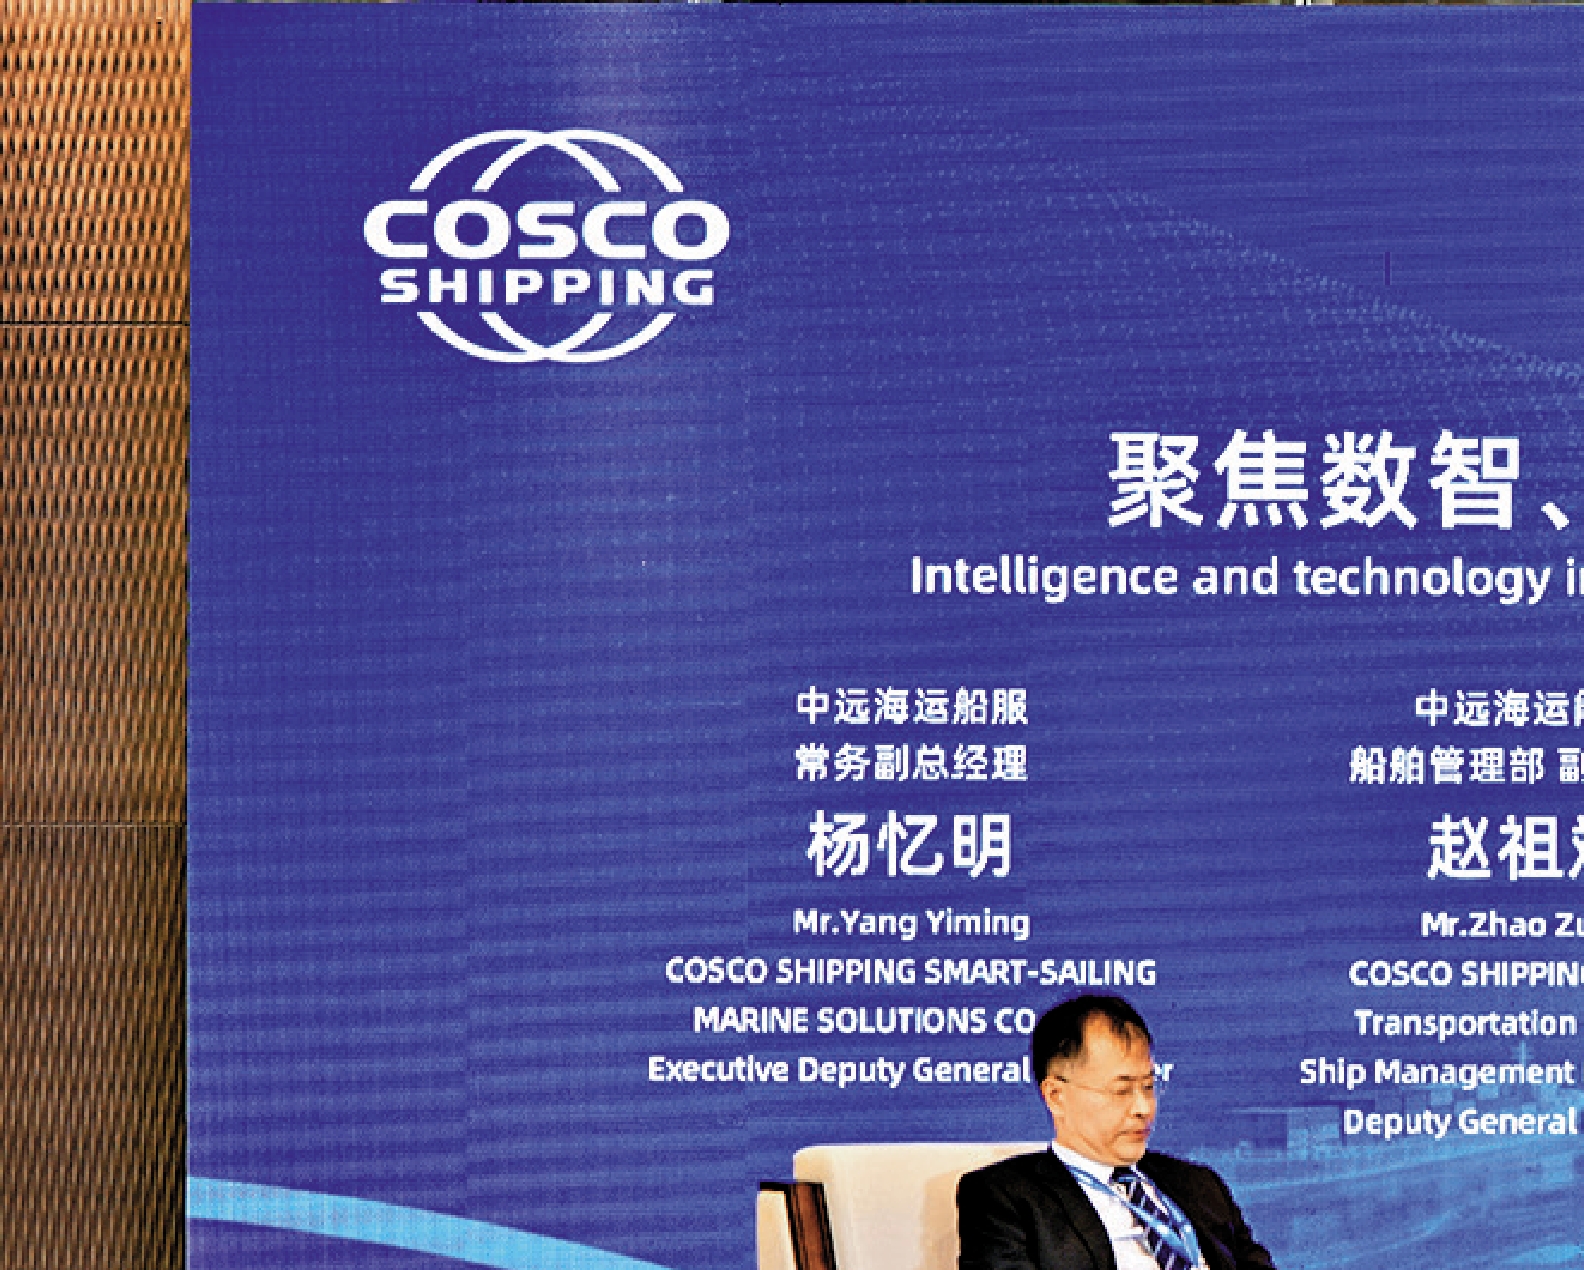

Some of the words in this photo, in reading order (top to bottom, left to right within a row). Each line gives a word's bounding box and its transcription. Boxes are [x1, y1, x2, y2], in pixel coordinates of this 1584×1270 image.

[363, 200, 730, 260] COSCO
[380, 268, 713, 306] SHIPPING
[912, 553, 1178, 605] Intelligence
[1192, 555, 1278, 595] and
[1293, 555, 1551, 605] technology
[797, 685, 1029, 725] 中远海运船服
[795, 742, 1029, 782] 常务副总经理
[1350, 744, 1544, 785] 船舶管理部
[807, 809, 1010, 878] 杨忆明
[795, 907, 916, 941] Mr.Yang
[926, 907, 1029, 941] Yiming
[1422, 910, 1547, 938] Mr.Zhao
[665, 955, 768, 984] COSCO
[775, 958, 916, 984] SHIPPING
[924, 958, 1156, 986] SMART-SAILING
[1348, 960, 1453, 986] COSCO
[694, 1006, 809, 1034] MARINE
[816, 1006, 988, 1034] SOLUTIONS
[1353, 1008, 1578, 1044] Transportation
[648, 1054, 789, 1082] Executive
[797, 1056, 907, 1089] Deputy
[912, 1056, 1031, 1084] General
[1300, 1056, 1367, 1091] Ship
[1374, 1058, 1575, 1091] Management
[1343, 1109, 1453, 1142] Deputy
[1458, 1106, 1578, 1135] General
